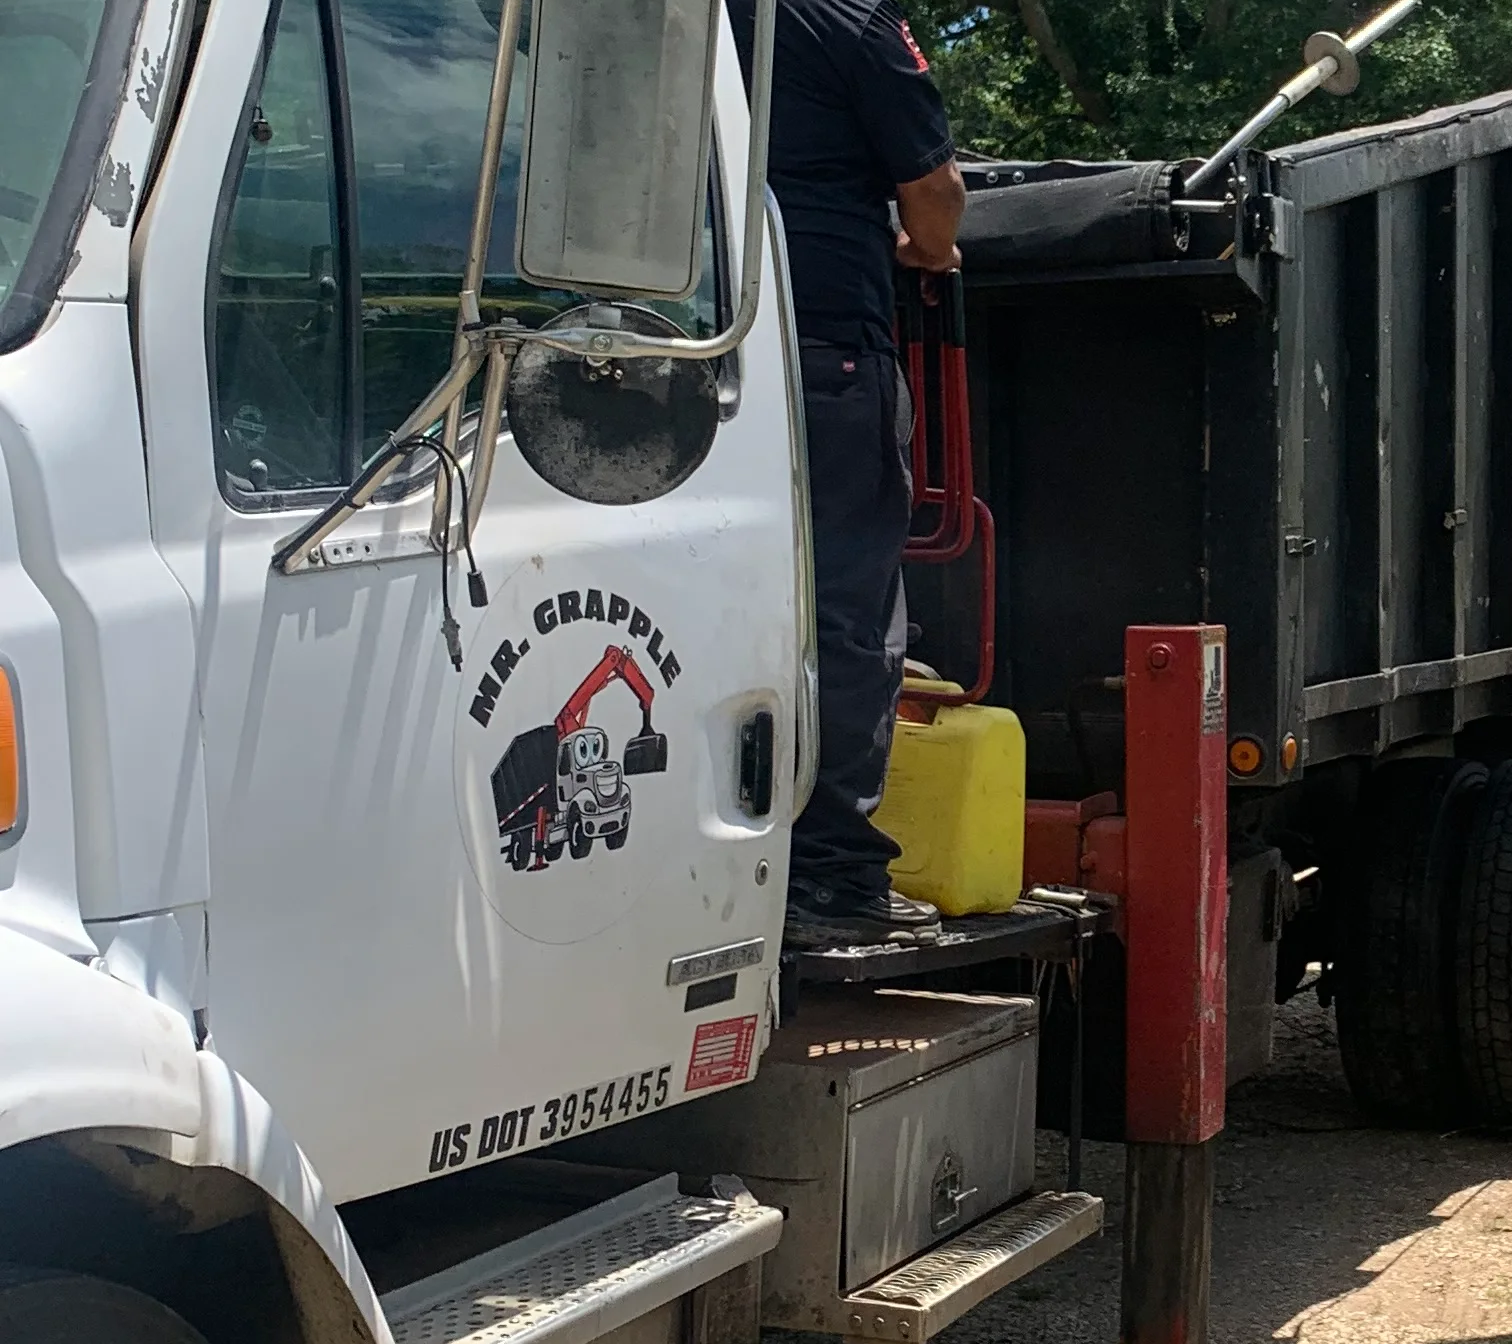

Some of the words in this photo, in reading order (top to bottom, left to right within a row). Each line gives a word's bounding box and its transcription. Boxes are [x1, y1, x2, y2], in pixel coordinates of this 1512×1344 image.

[469, 638, 531, 728] MR.
[533, 588, 682, 689] GRAPPLE
[429, 1123, 471, 1173] US
[477, 1105, 535, 1159] DOT
[540, 1065, 671, 1140] 3954455
